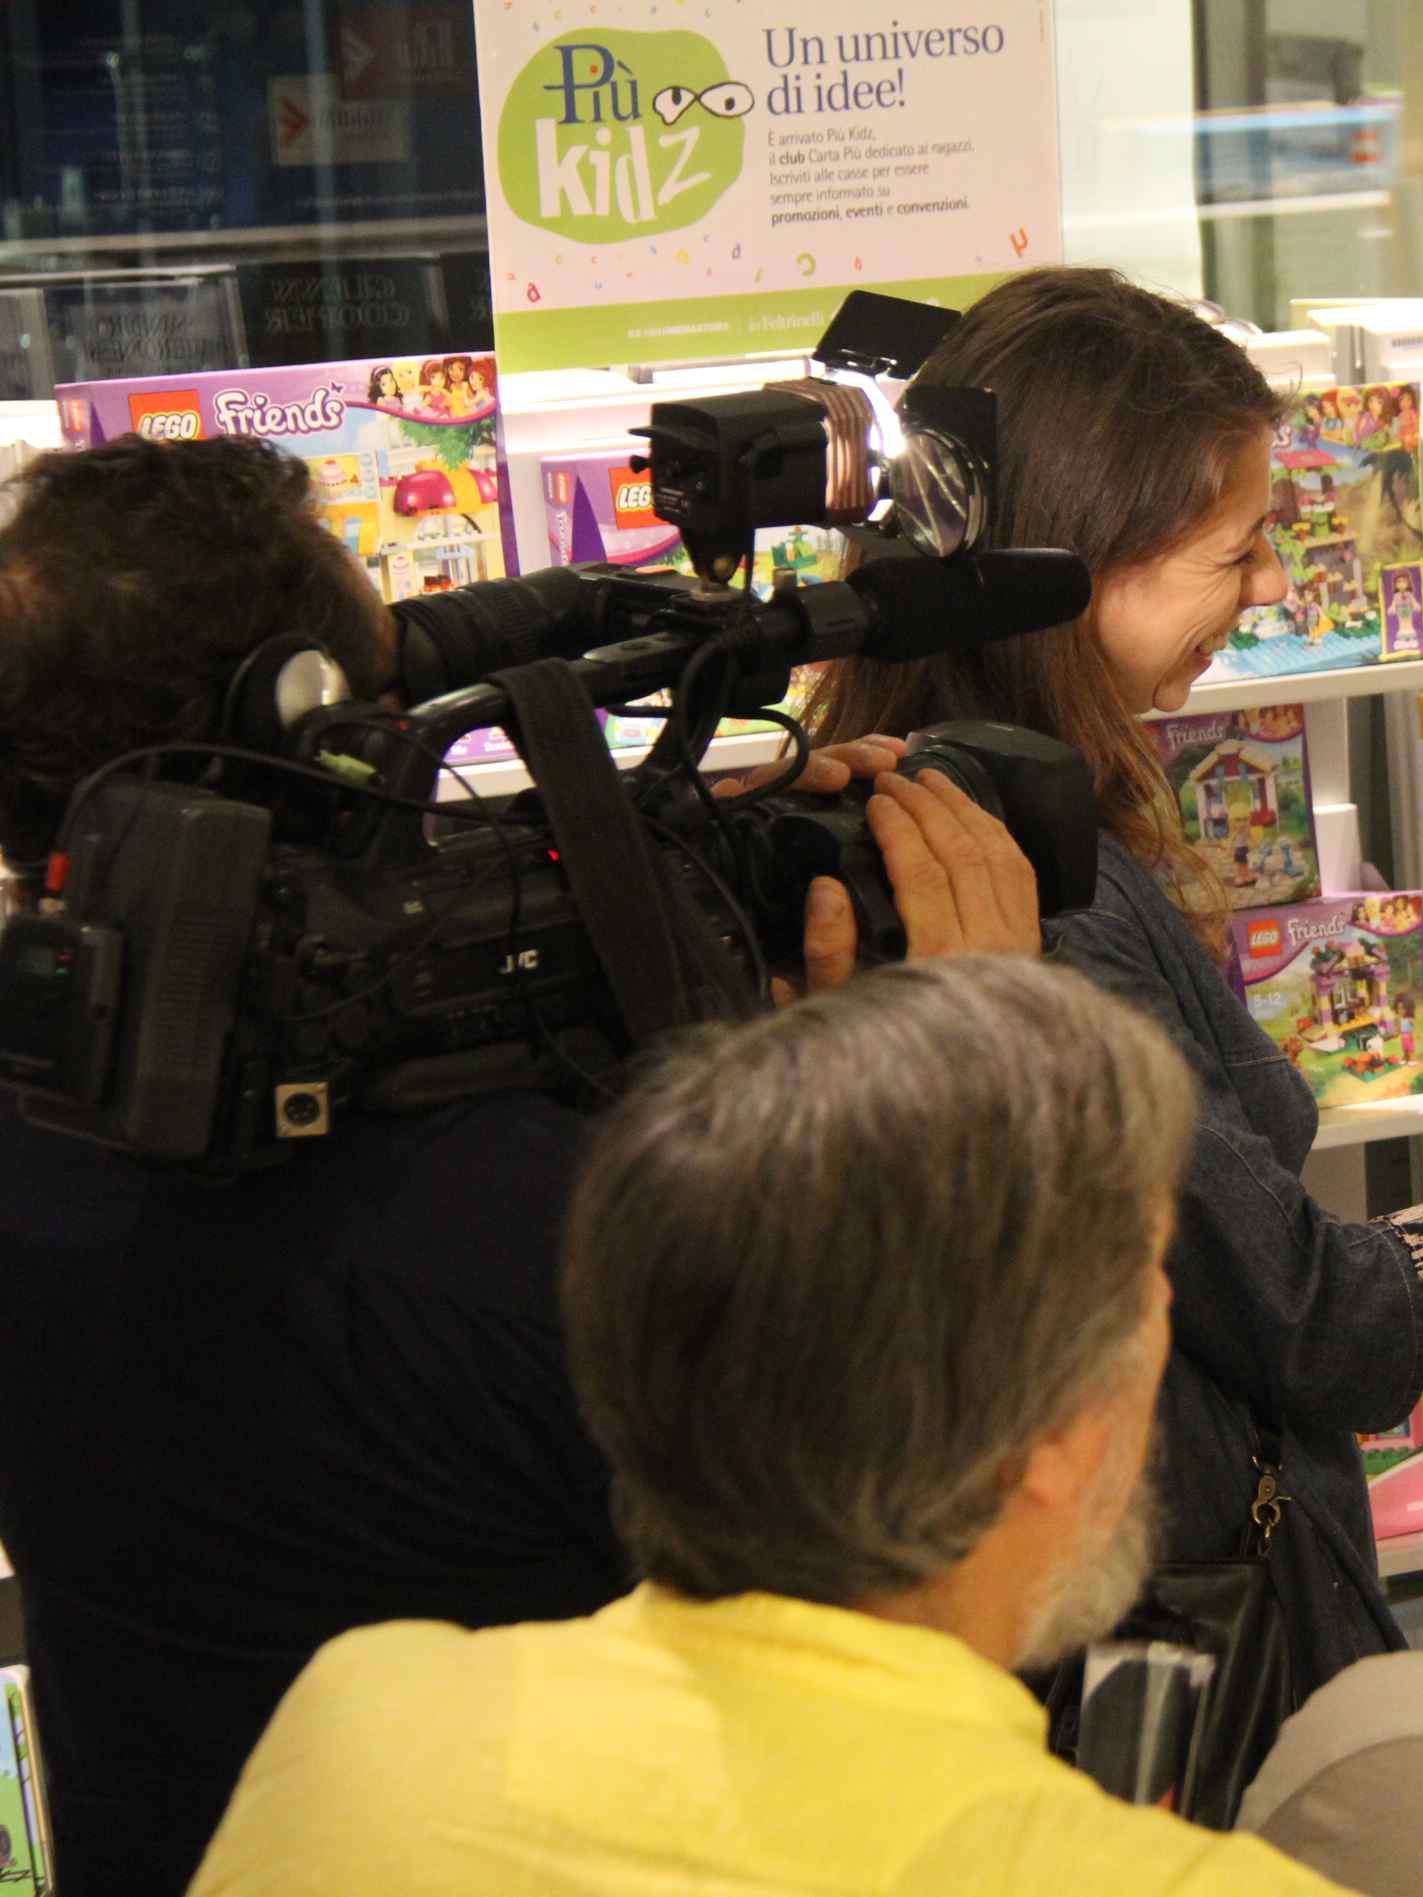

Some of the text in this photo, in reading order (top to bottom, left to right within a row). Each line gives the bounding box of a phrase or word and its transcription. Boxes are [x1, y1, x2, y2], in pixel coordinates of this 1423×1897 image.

[762, 20, 1005, 68] Un universo
[543, 44, 641, 124] Più
[767, 67, 905, 115] di idee!
[779, 130, 824, 146] arrivato
[827, 126, 845, 143] Più
[768, 152, 776, 166] il
[779, 150, 805, 165] club
[809, 147, 840, 163] Carta
[843, 145, 862, 161] Più
[865, 142, 914, 159] dedicato
[918, 141, 928, 155] ai
[535, 117, 712, 225] kidz
[770, 163, 930, 185] Iscriviti alle casse per essere
[770, 185, 890, 207] sempre informato su
[846, 203, 883, 219] eventi
[886, 206, 895, 217] e
[139, 411, 200, 441] LEGO
[214, 387, 345, 437] Friends
[616, 482, 652, 512] LEG
[1167, 719, 1225, 751] Friends
[1251, 930, 1279, 945] LEGO
[1287, 911, 1346, 947] Friends
